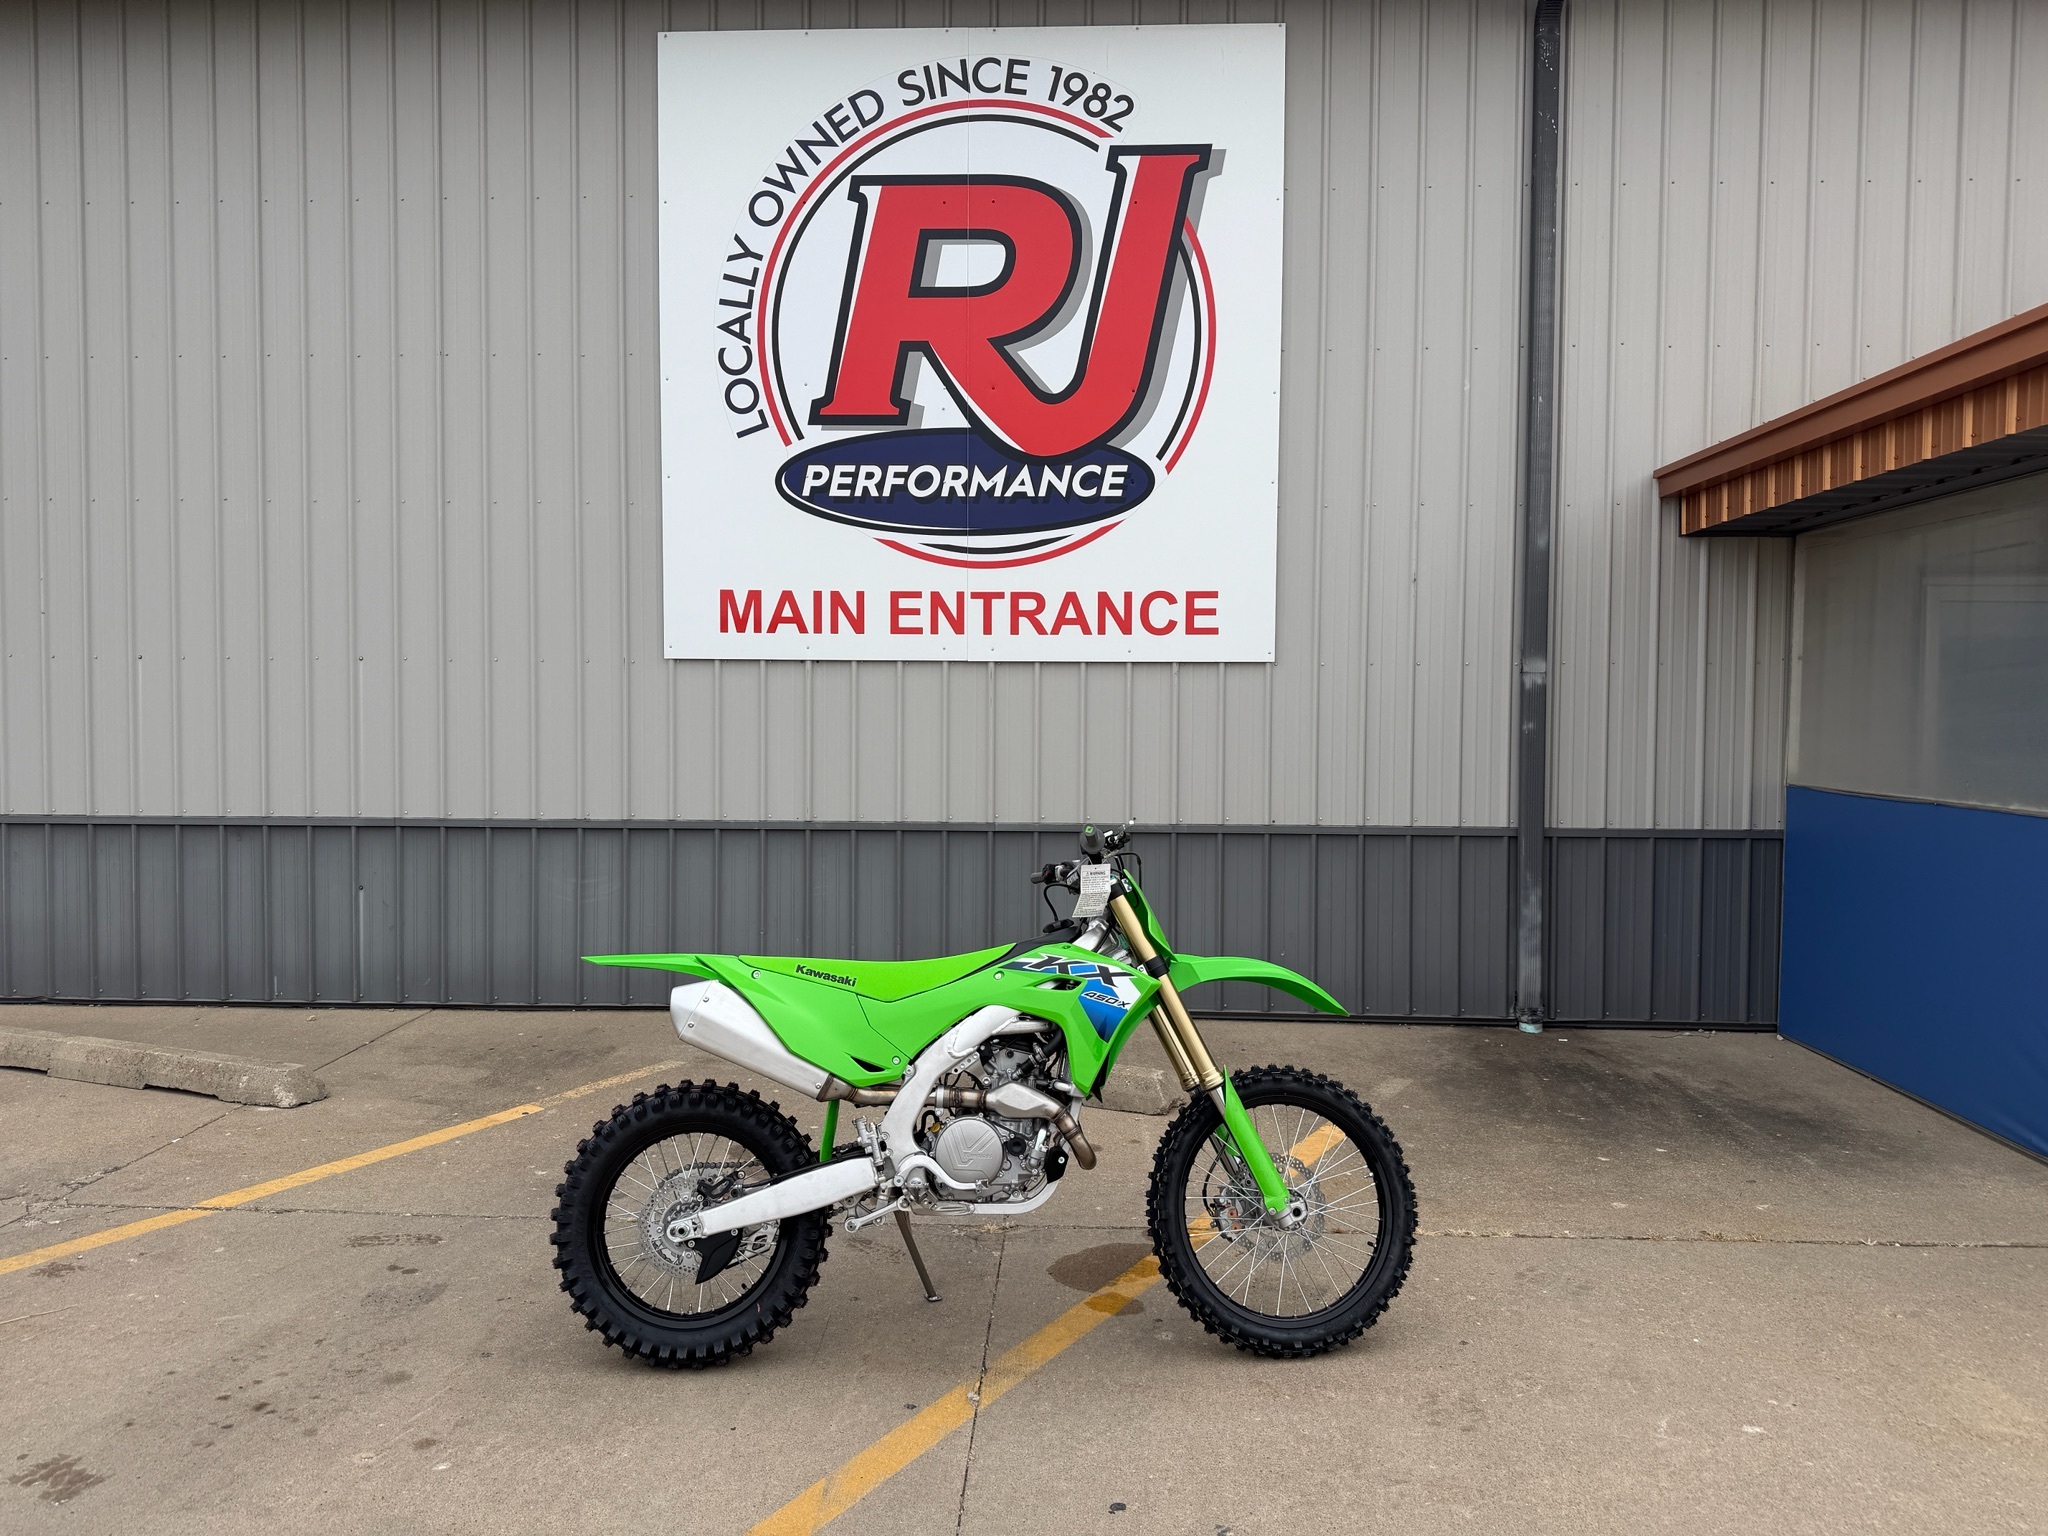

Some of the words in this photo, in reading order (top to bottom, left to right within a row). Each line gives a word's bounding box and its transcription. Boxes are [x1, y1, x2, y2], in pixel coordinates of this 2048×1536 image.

[717, 233, 769, 439] LOCALLY
[748, 89, 884, 227] OWNED
[897, 56, 1031, 107] SINCE
[1047, 65, 1135, 133] 1982
[808, 143, 1213, 456] RJ
[801, 464, 1129, 498] PERFORMANCE
[719, 588, 865, 635] MAIN
[889, 589, 1219, 636] ENTRANCE
[795, 964, 857, 987] Kawasaki
